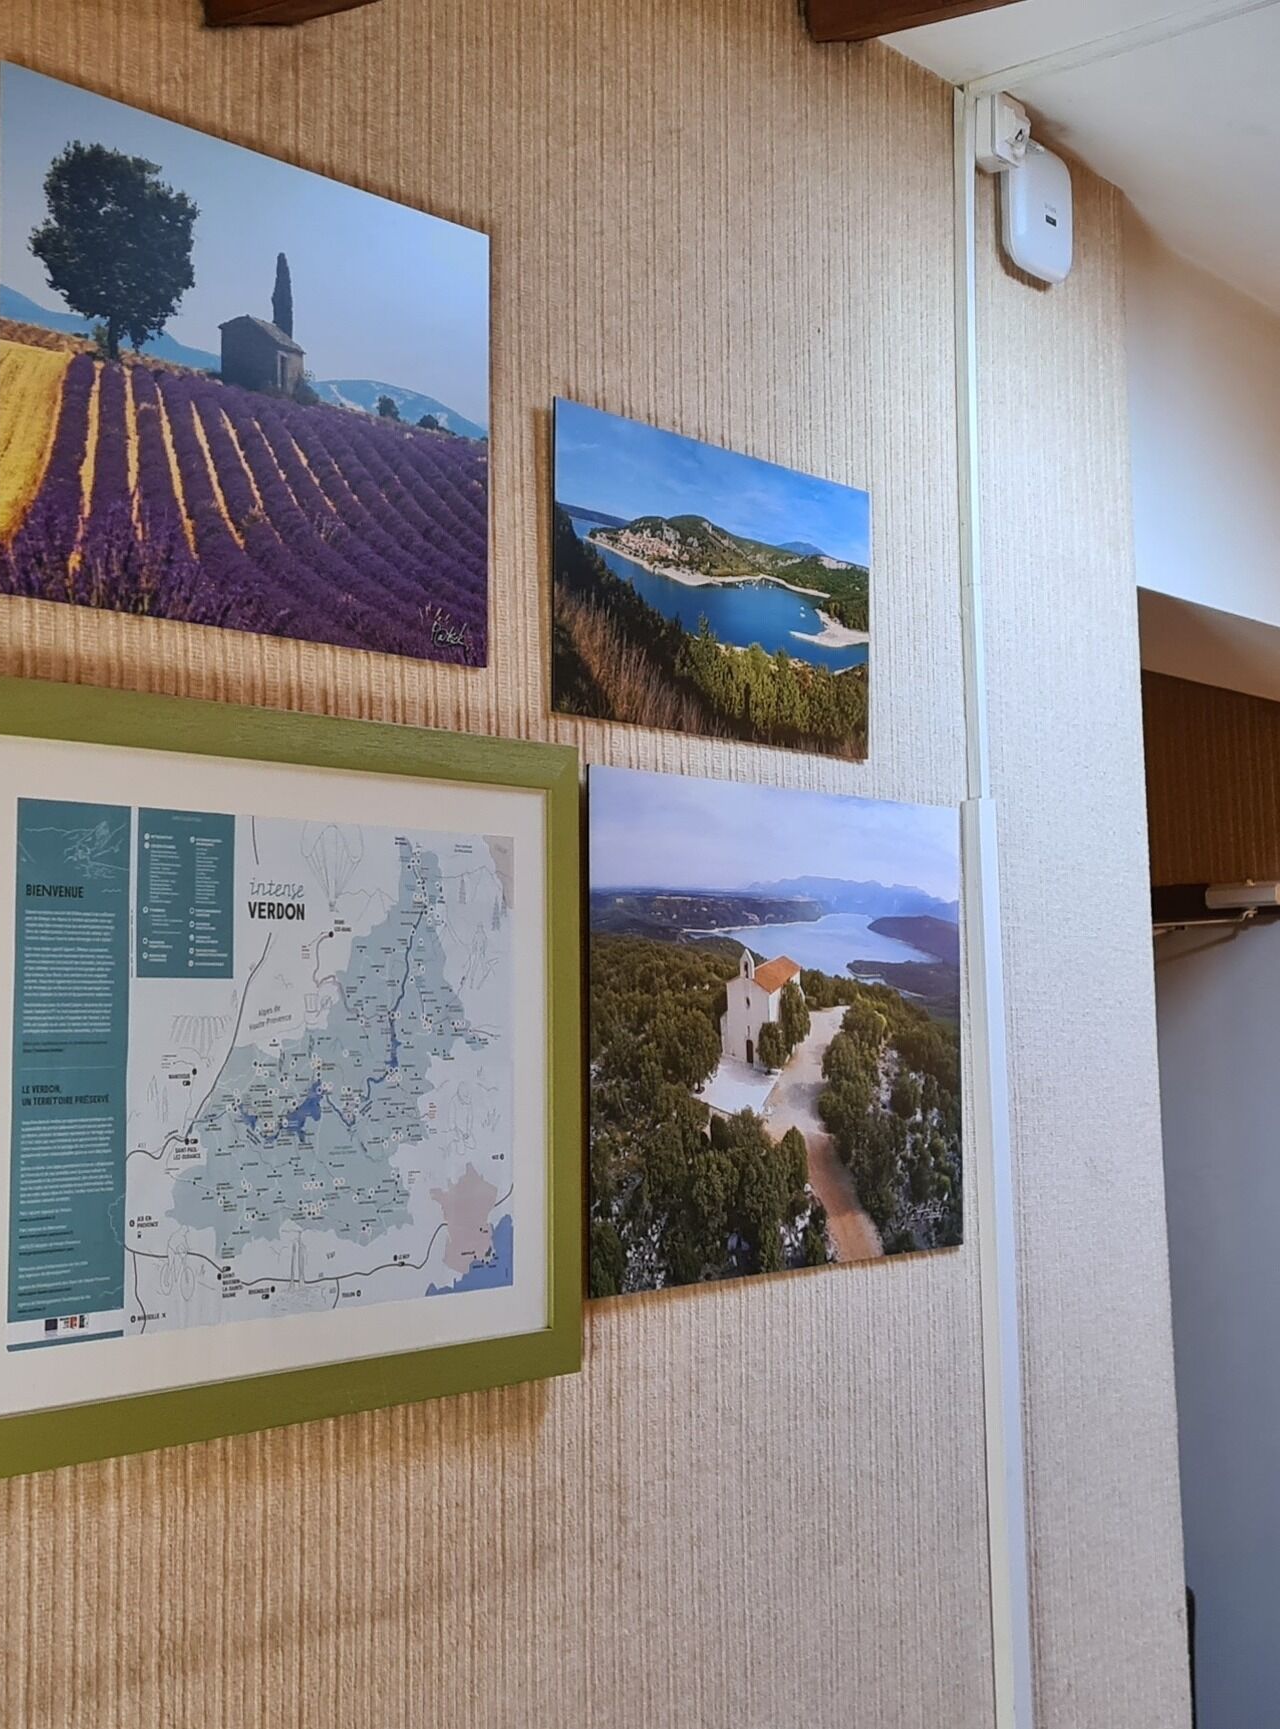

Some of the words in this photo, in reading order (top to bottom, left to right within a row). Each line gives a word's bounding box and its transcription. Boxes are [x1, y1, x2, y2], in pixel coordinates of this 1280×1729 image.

[26, 884, 84, 898] BIENVENUE
[249, 877, 305, 900] intense
[248, 901, 305, 920] VERDON
